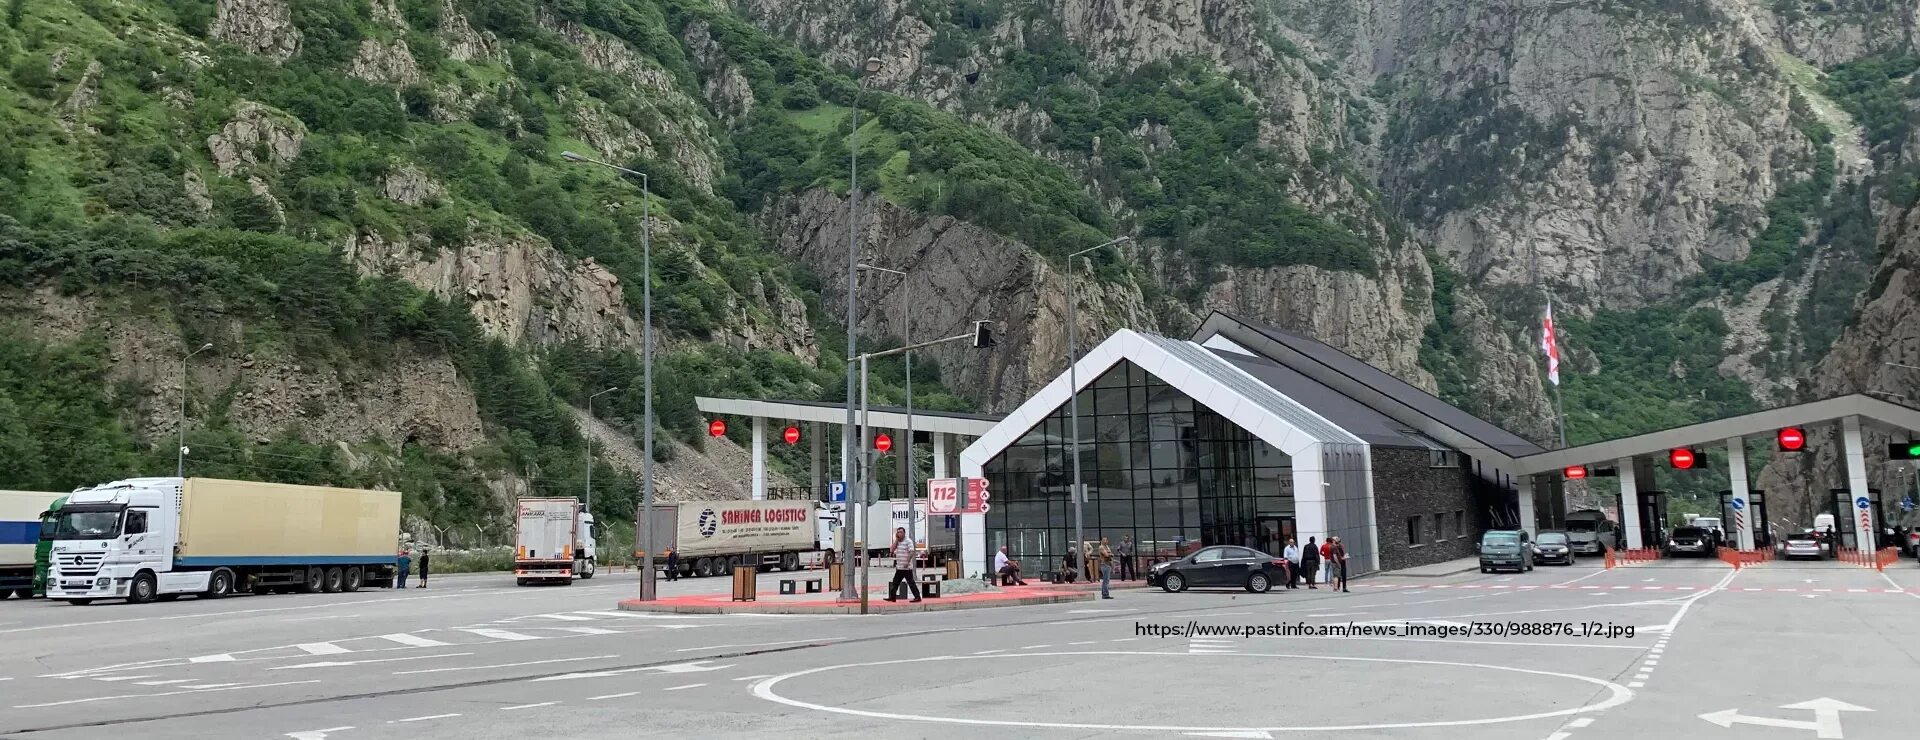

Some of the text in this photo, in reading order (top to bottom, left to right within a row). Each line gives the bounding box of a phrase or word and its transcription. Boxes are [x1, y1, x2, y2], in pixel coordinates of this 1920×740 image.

[832, 483, 843, 500] P
[934, 487, 956, 500] 112
[764, 508, 806, 523] LOGISTICS
[892, 510, 919, 519] KAYA
